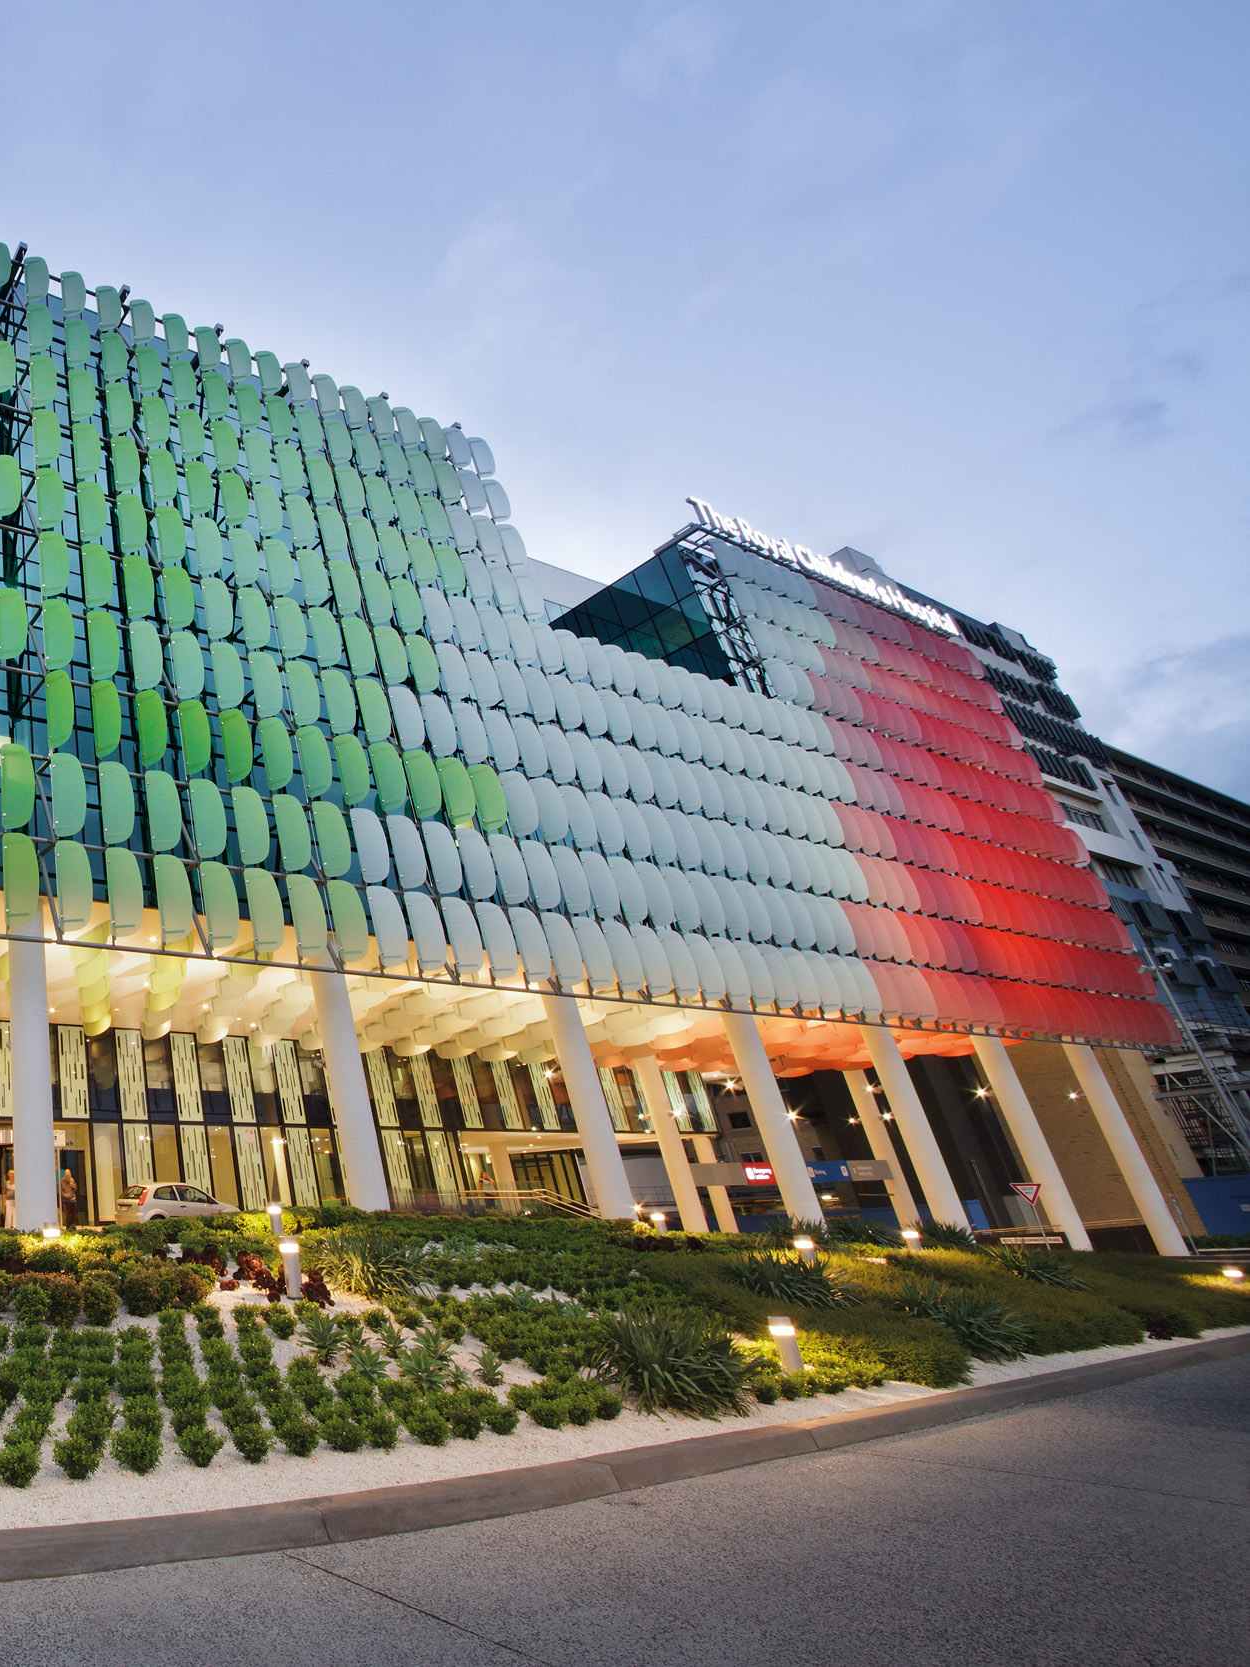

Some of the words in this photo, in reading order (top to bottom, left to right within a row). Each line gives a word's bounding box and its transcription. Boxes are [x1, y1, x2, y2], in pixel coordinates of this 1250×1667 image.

[686, 496, 741, 537] The
[735, 517, 798, 562] Royal
[794, 543, 893, 606] Children's
[886, 585, 960, 636] Hospital
